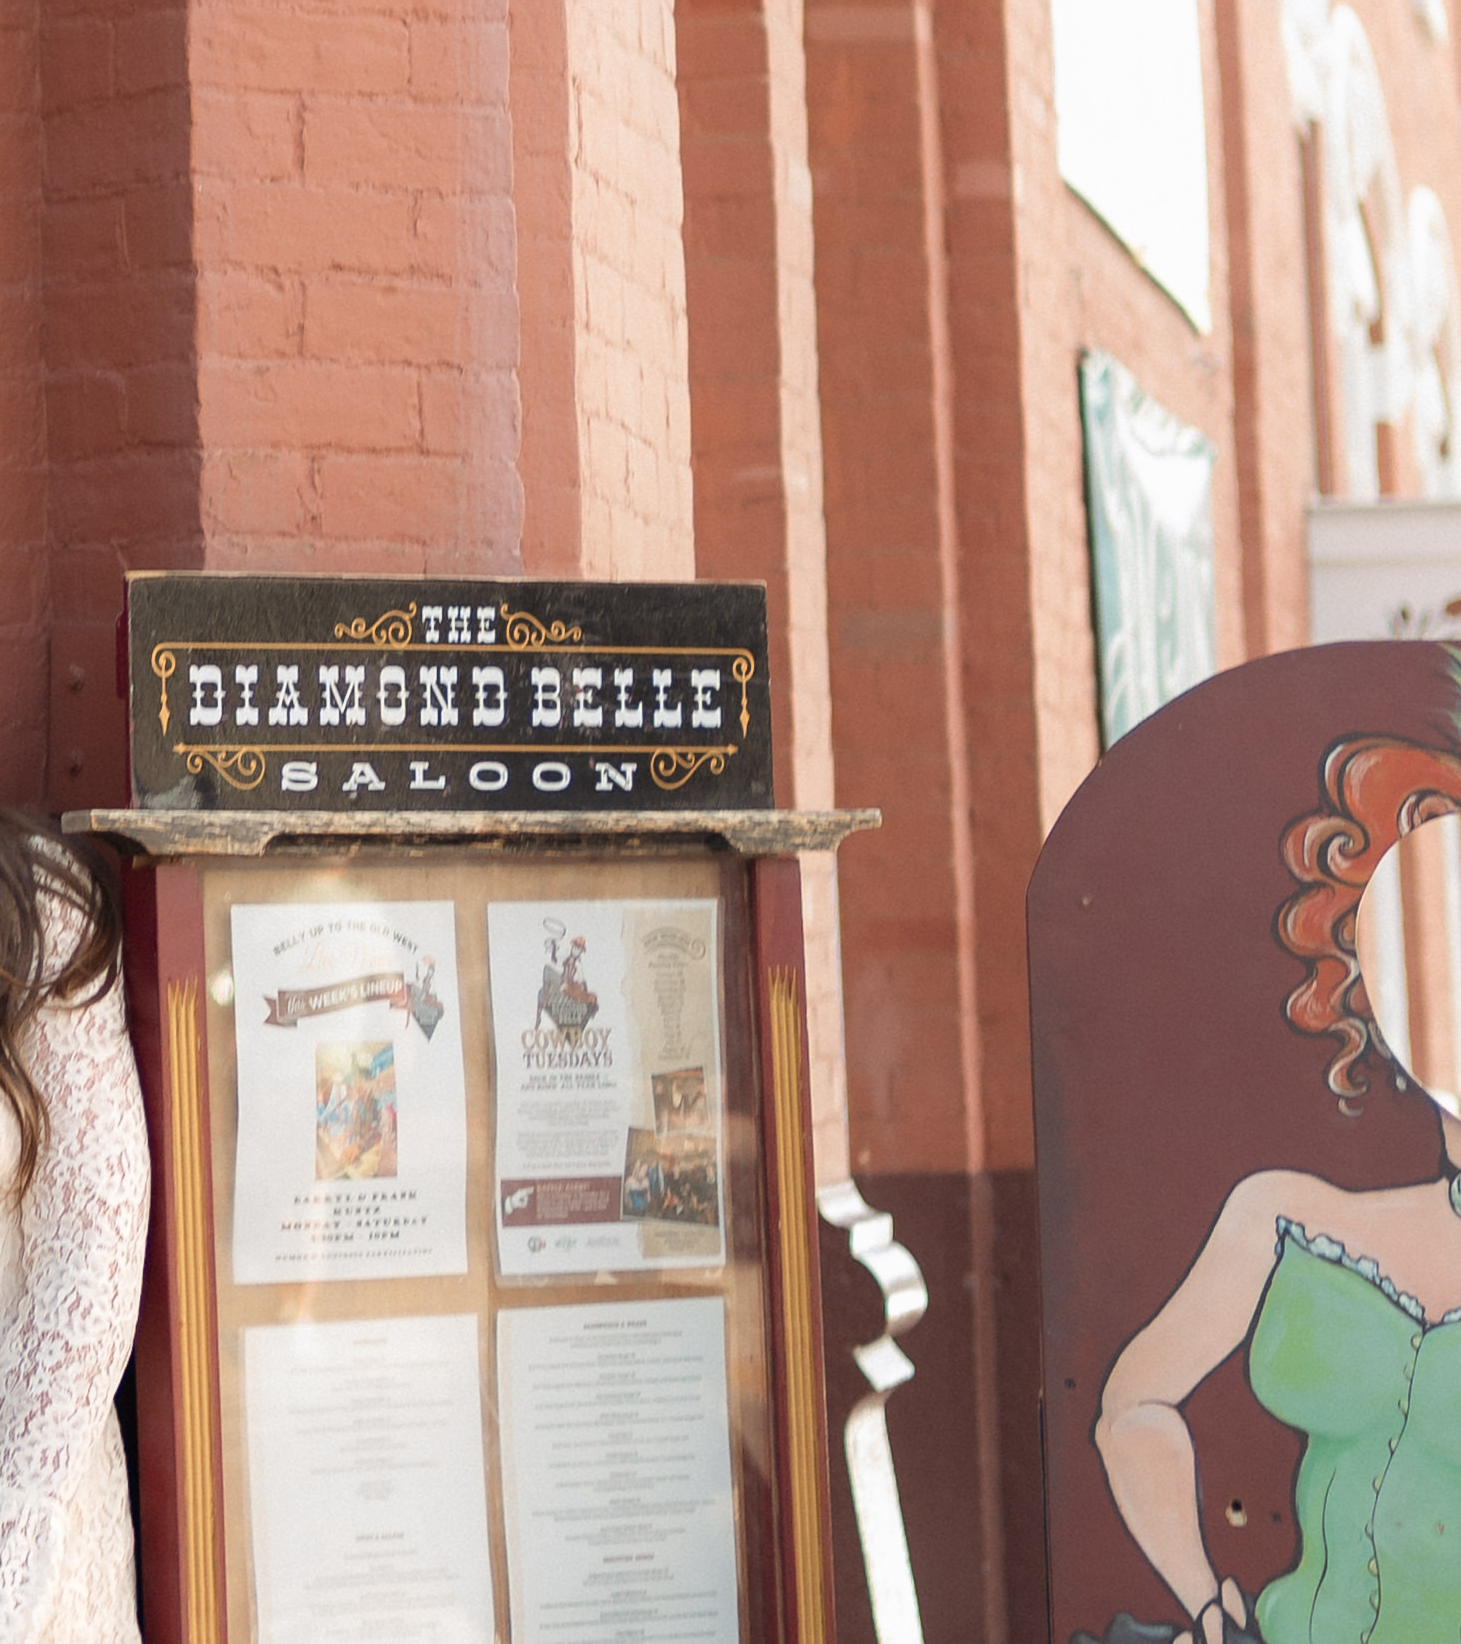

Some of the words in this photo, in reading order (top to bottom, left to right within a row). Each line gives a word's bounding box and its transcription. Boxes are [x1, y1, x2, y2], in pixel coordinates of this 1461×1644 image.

[421, 605, 497, 645] THE
[189, 663, 509, 728] DIAMOND
[530, 666, 723, 730] BELLE
[280, 761, 638, 793] SALOON
[329, 922, 342, 932] TO
[347, 921, 365, 931] THE
[393, 930, 418, 955] WEST
[359, 979, 403, 999] LINEUP
[521, 1026, 613, 1051] COWBOY
[522, 1050, 613, 1069] TUESDAYS
